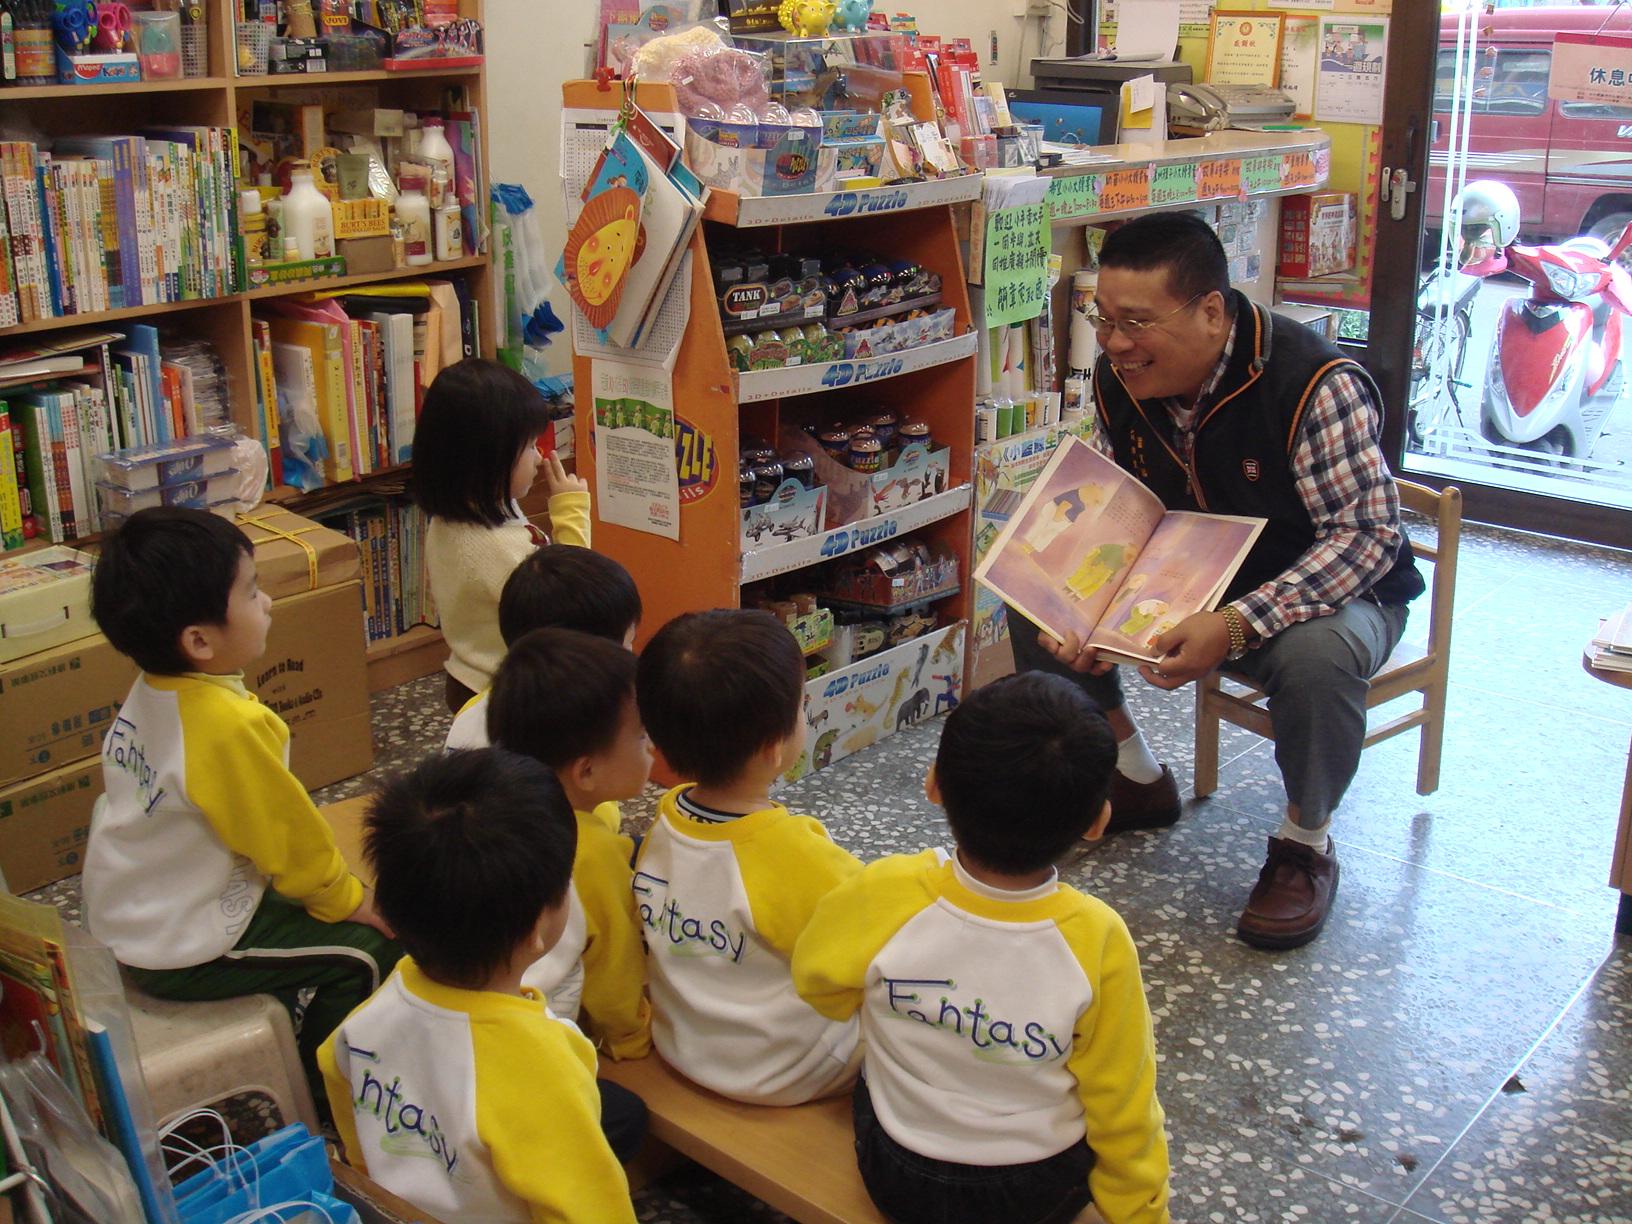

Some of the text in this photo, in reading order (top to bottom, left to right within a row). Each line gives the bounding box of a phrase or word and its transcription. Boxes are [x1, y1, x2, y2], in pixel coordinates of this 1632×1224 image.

[824, 191, 908, 217] 4D Puzzle
[367, 218, 386, 228] BEES
[732, 289, 761, 302] TANK
[821, 358, 904, 387] 4D Puzzle
[820, 519, 898, 558] 4D Puzzle
[257, 666, 278, 688] Learn
[823, 663, 890, 698] 4D Puzzle
[344, 1040, 457, 1173] ntasy
